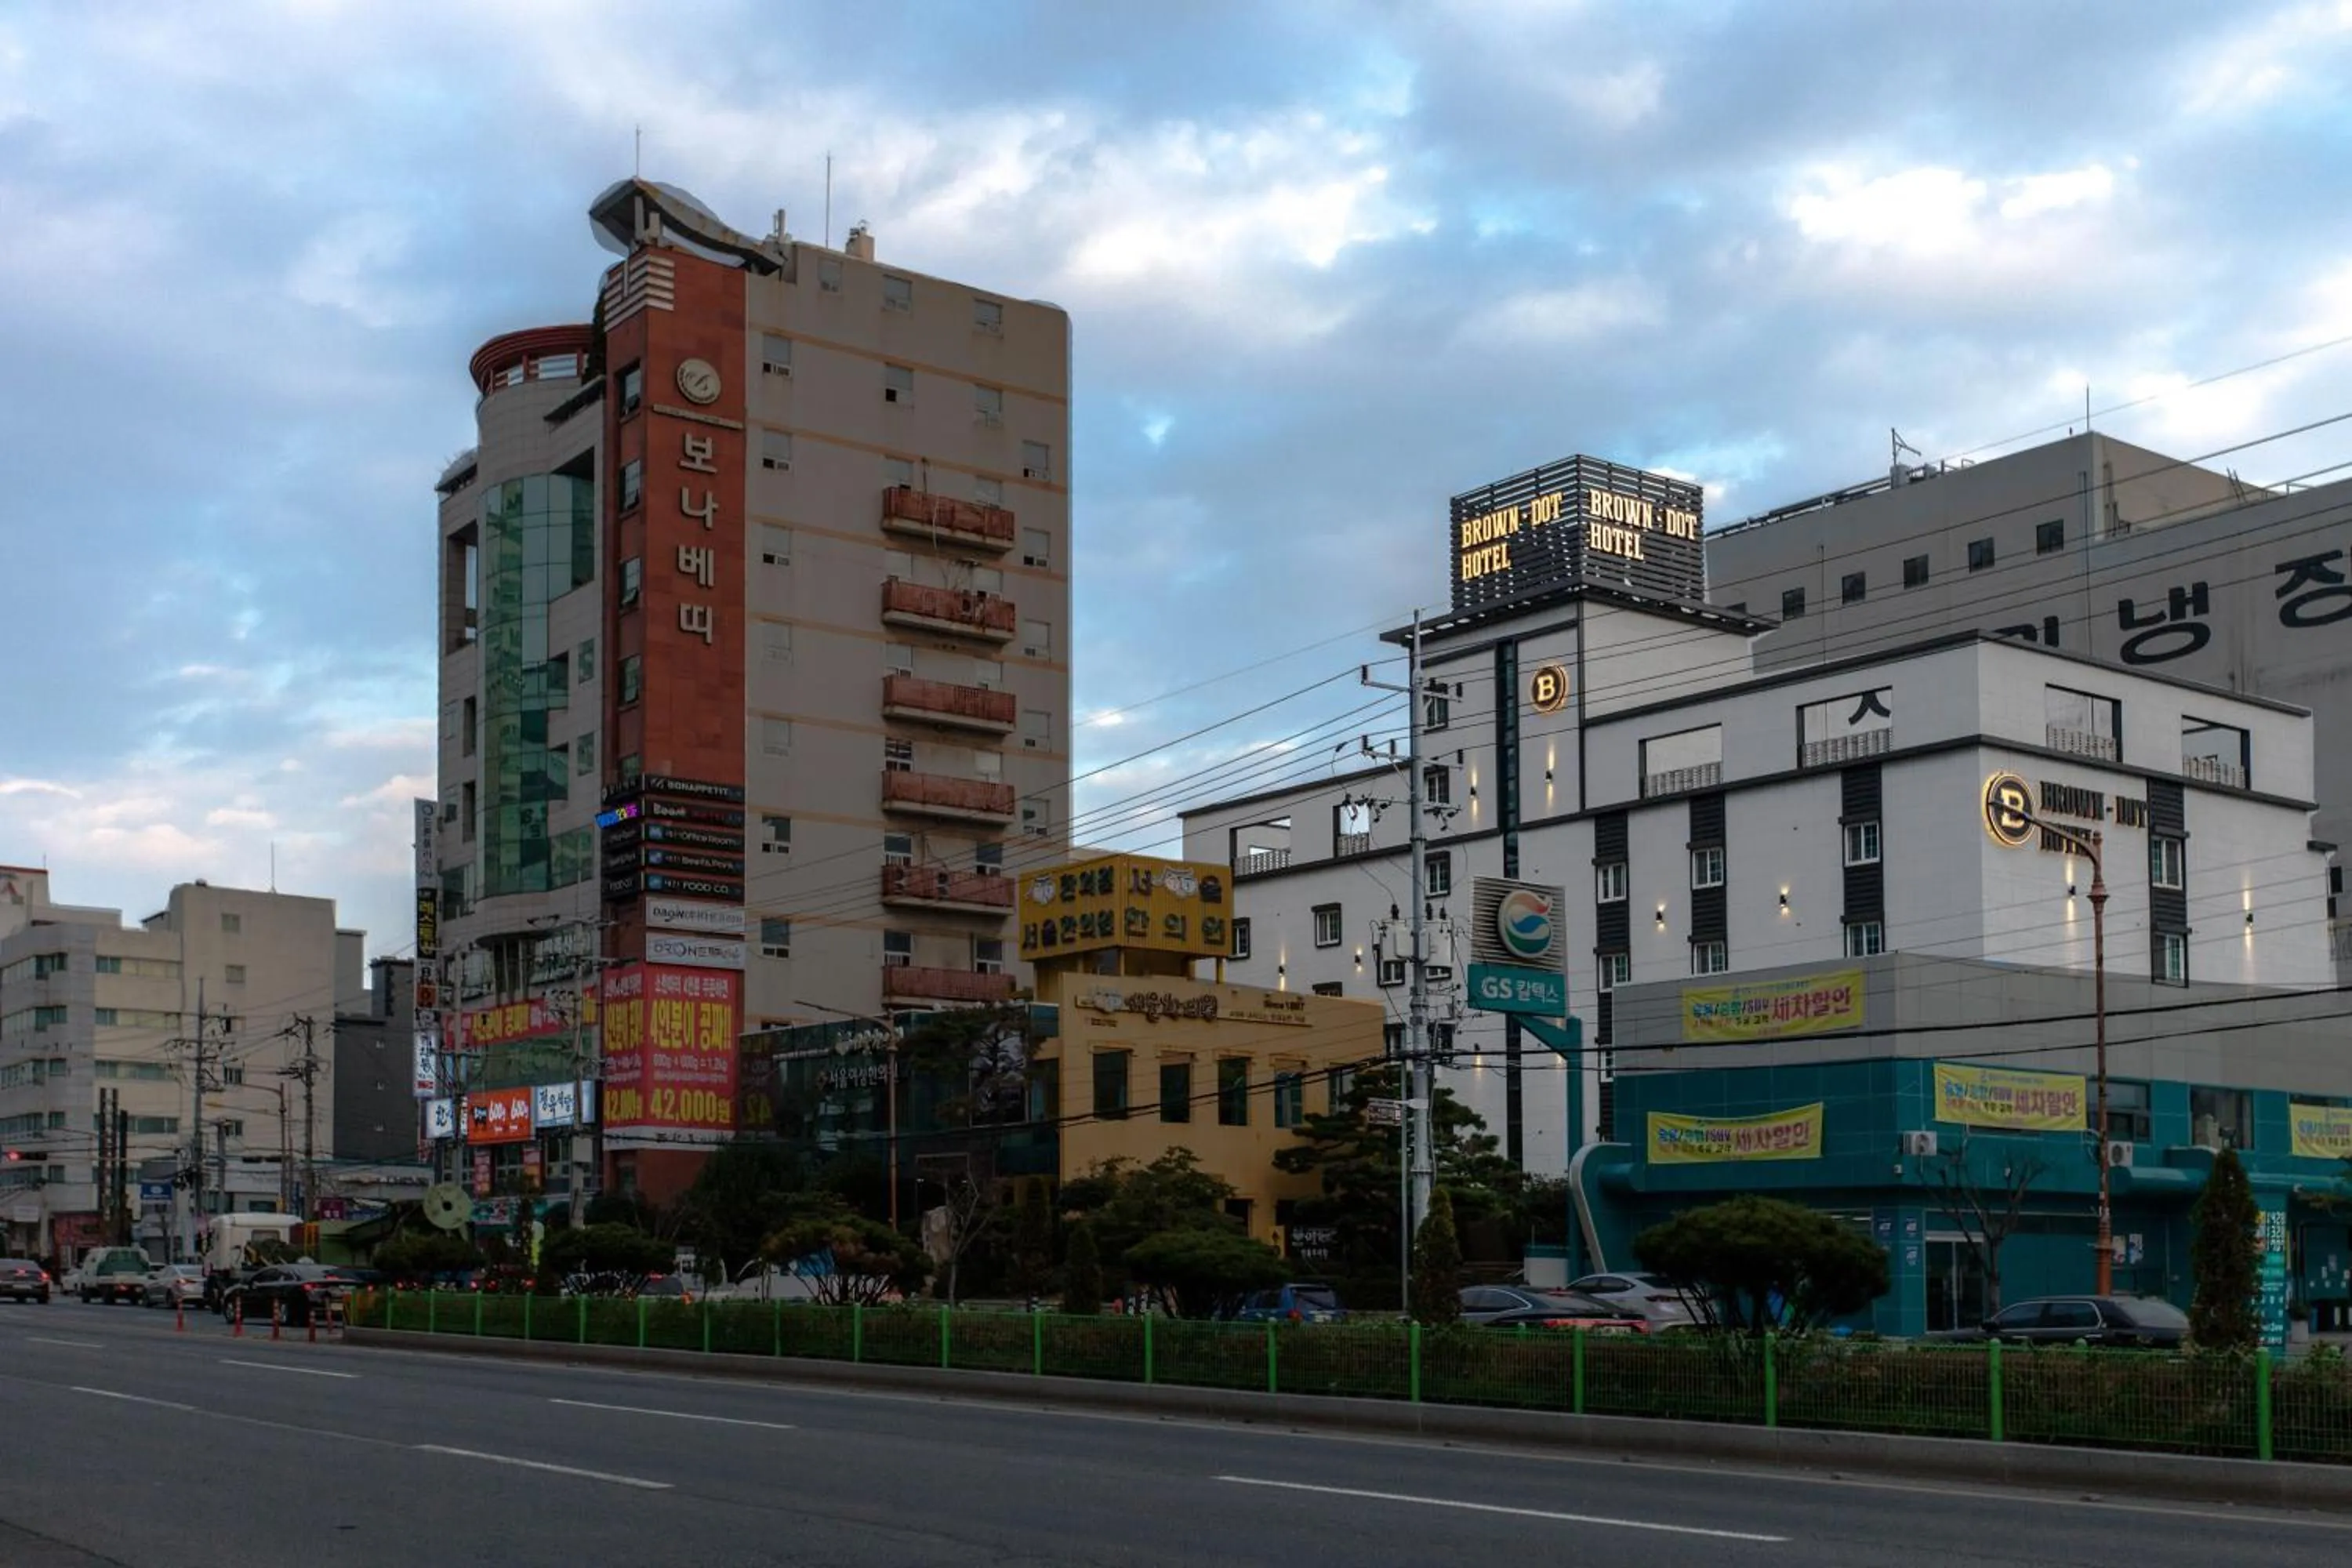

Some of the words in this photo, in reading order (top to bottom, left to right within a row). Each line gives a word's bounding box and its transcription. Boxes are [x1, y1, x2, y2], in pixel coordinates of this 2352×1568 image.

[1461, 506, 1519, 548] BROWN
[1530, 492, 1563, 526] DOT
[1590, 488, 1653, 529] BROWN
[1666, 508, 1697, 540] DOT
[679, 433, 718, 644] 보나베띠
[1590, 522, 1644, 560] HOTEL
[1462, 543, 1511, 580] HOTEL
[1537, 675, 1555, 702] B
[2040, 781, 2105, 820] BROWN
[2115, 795, 2147, 828] DOT
[1481, 975, 1513, 1000] GS
[1516, 979, 1559, 1004] 칼텍스
[1772, 985, 1851, 1022] 세차할인
[650, 999, 695, 1050] 4인분이
[699, 1002, 732, 1052] 공짜!!
[650, 1087, 731, 1123] 42,000원
[2014, 1087, 2077, 1117] 세차할인
[1735, 1120, 1810, 1152] 세차할인
